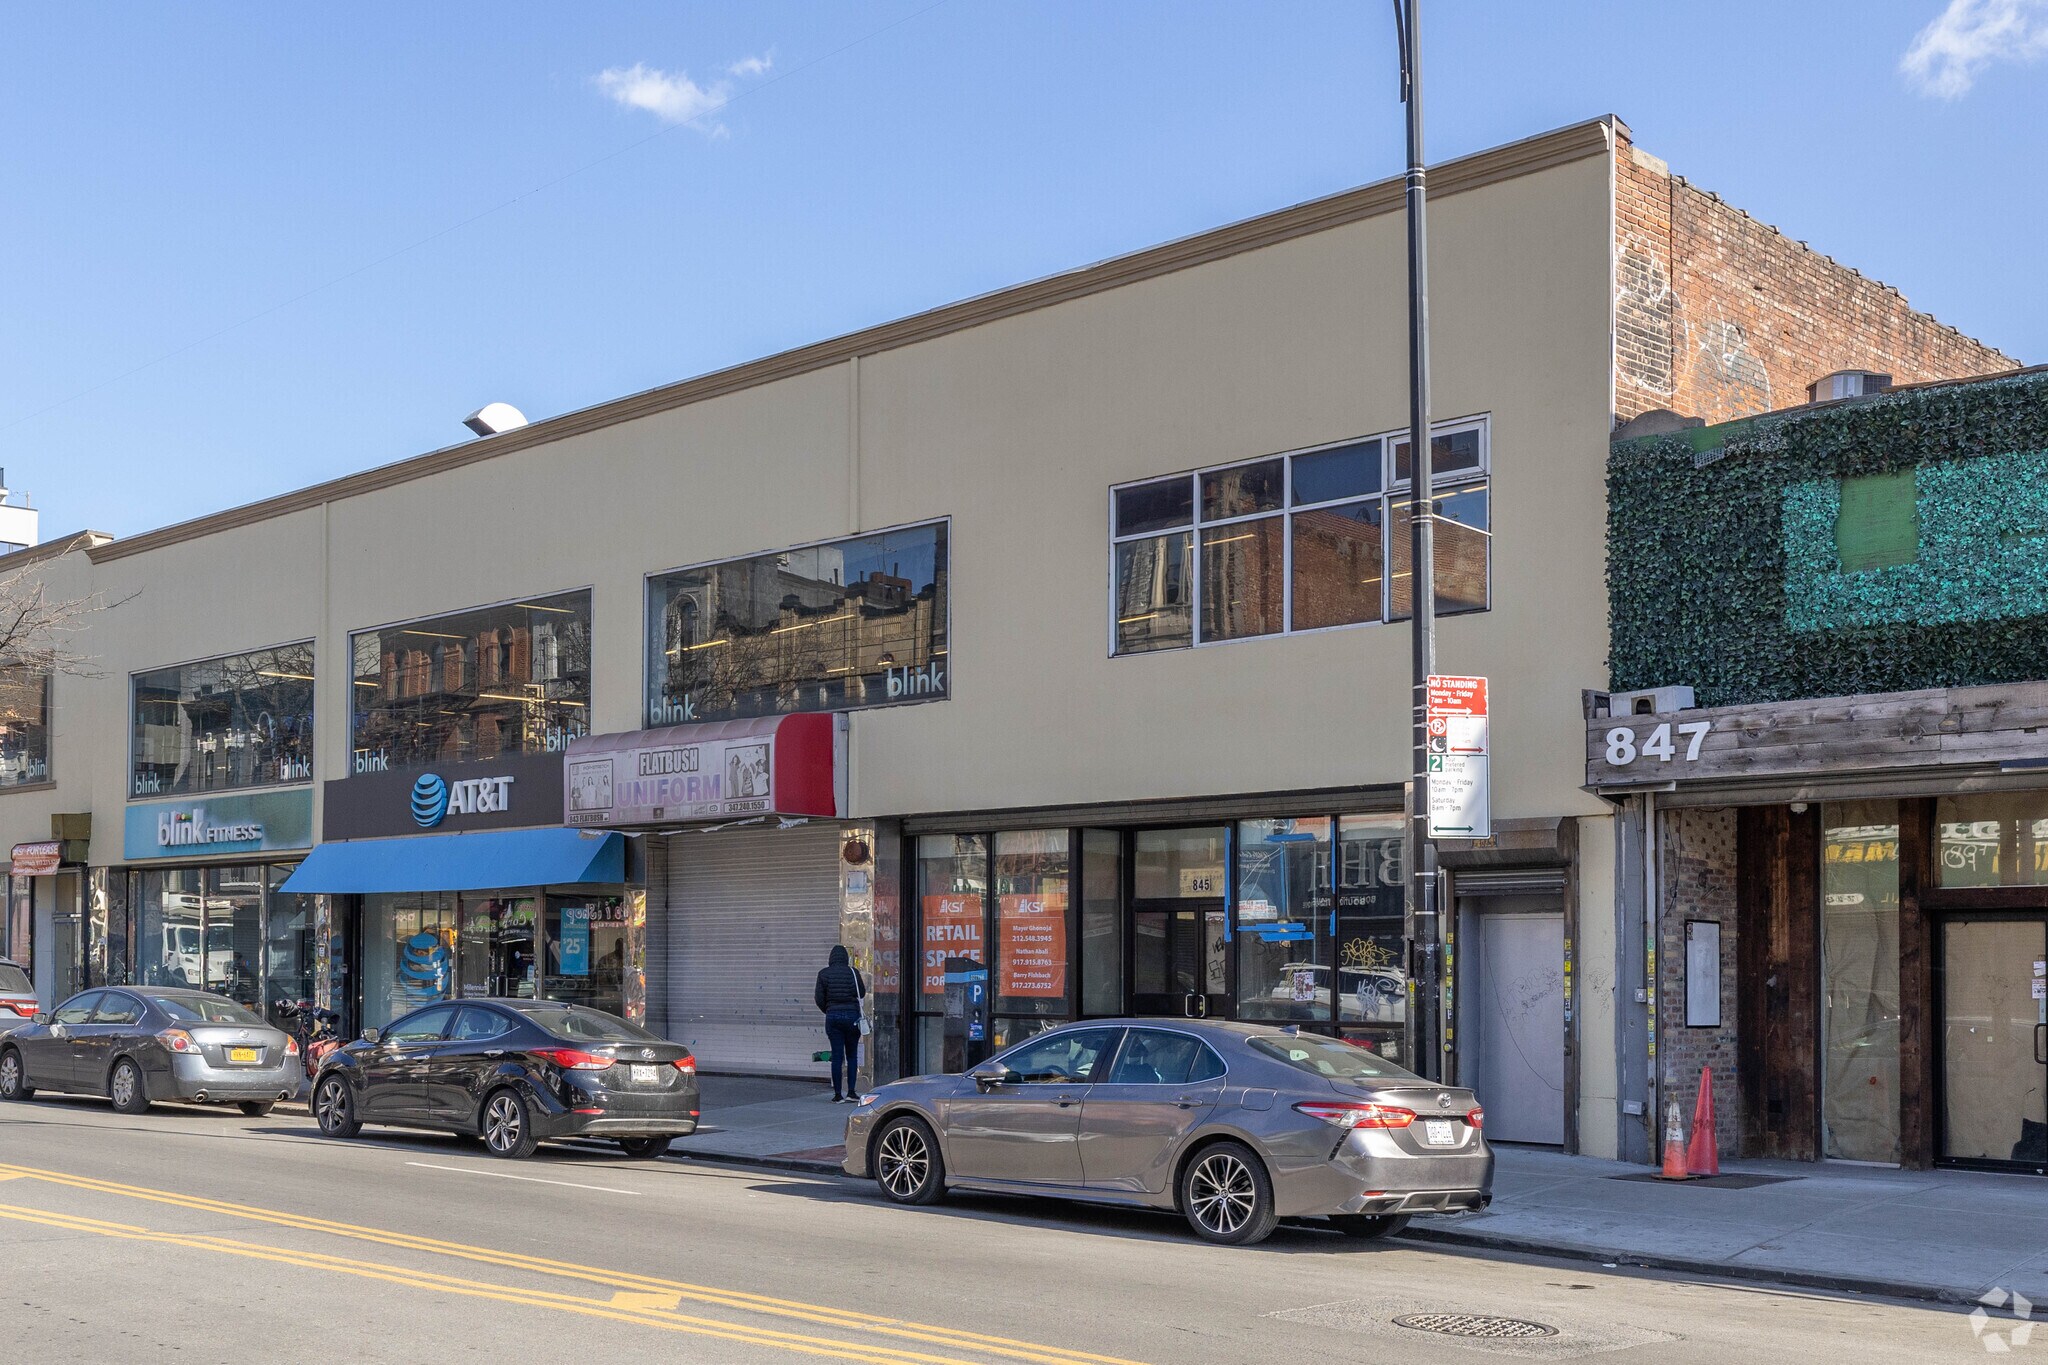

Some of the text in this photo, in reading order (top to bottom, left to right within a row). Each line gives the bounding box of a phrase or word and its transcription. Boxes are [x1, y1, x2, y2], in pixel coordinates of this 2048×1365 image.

[887, 662, 944, 698] blink
[1430, 680, 1478, 689] NO STANDING
[1431, 689, 1451, 697] Monday
[1456, 690, 1474, 698] Friday
[650, 694, 696, 724] blink
[1605, 721, 1711, 766] 847
[29, 757, 47, 777] blin
[280, 755, 310, 780] blink
[355, 748, 389, 773] blink
[639, 748, 699, 776] FLATBUSH
[1430, 755, 1441, 772] 2
[135, 773, 161, 794] blink
[446, 776, 515, 815] AT&T
[616, 774, 721, 808] UNIFORM
[158, 808, 263, 846] blink FITNESS
[1192, 879, 1210, 891] 845
[926, 924, 981, 941] RETAIL
[925, 975, 946, 987] FOR
